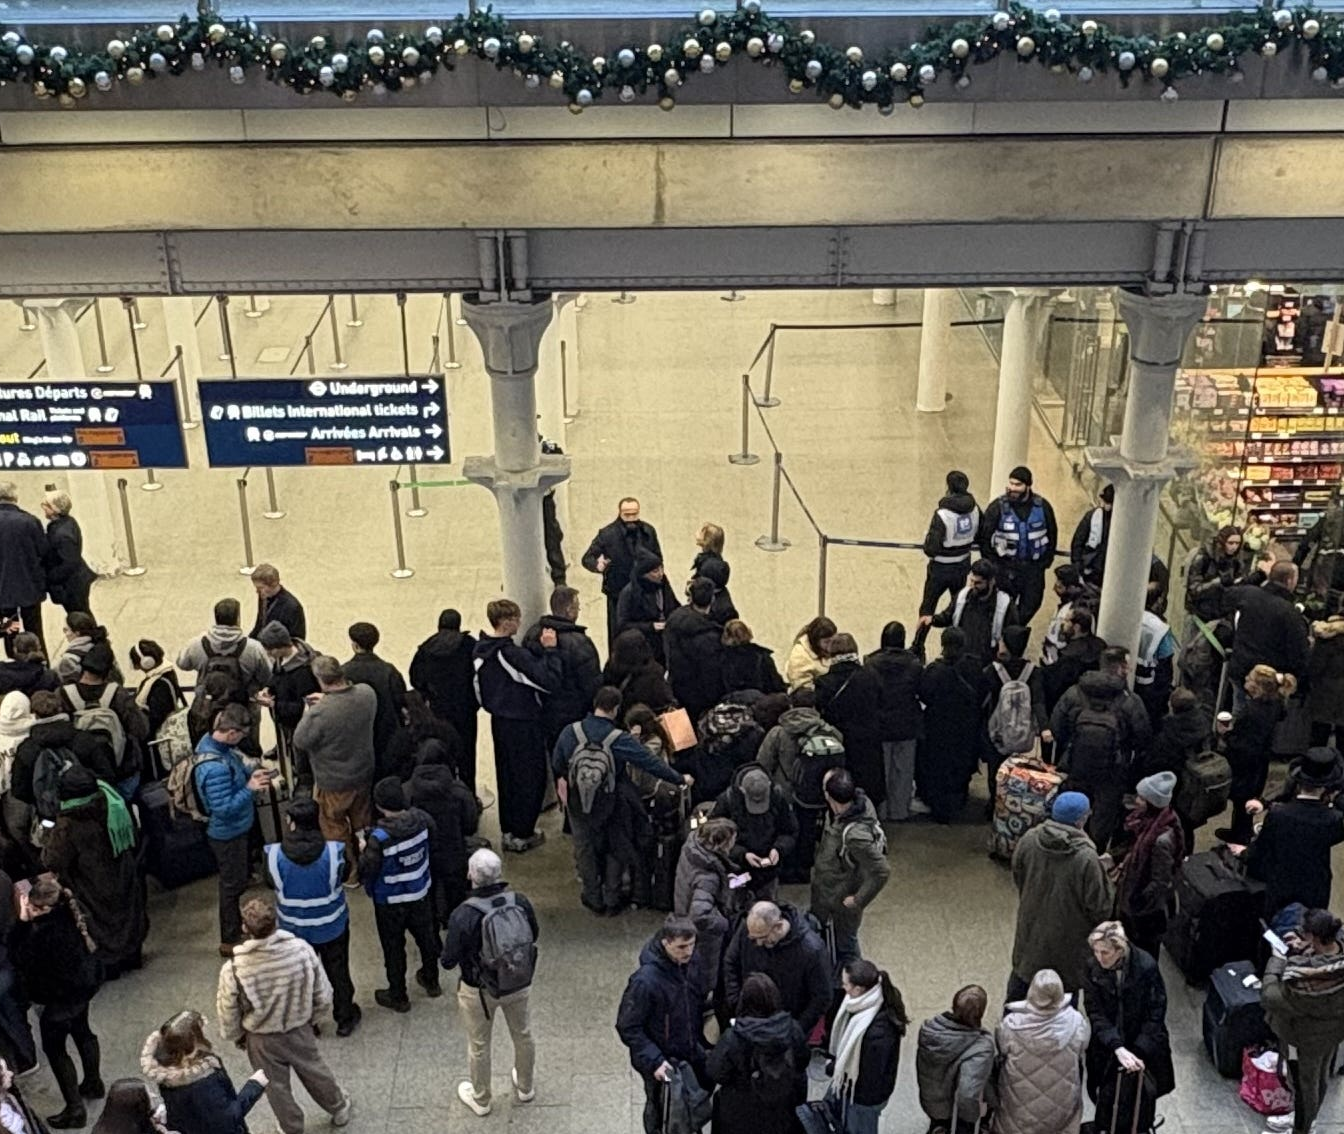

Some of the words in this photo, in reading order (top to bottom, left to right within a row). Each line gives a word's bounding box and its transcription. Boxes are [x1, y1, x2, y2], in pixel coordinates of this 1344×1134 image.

[34, 385, 88, 402] Départs
[329, 380, 418, 397] Underground
[19, 408, 48, 422] Rail
[242, 405, 286, 419] Billets
[287, 404, 372, 418] International
[373, 403, 418, 416] tickets
[310, 426, 366, 440] Arrivées
[368, 425, 421, 439] Arrivals
